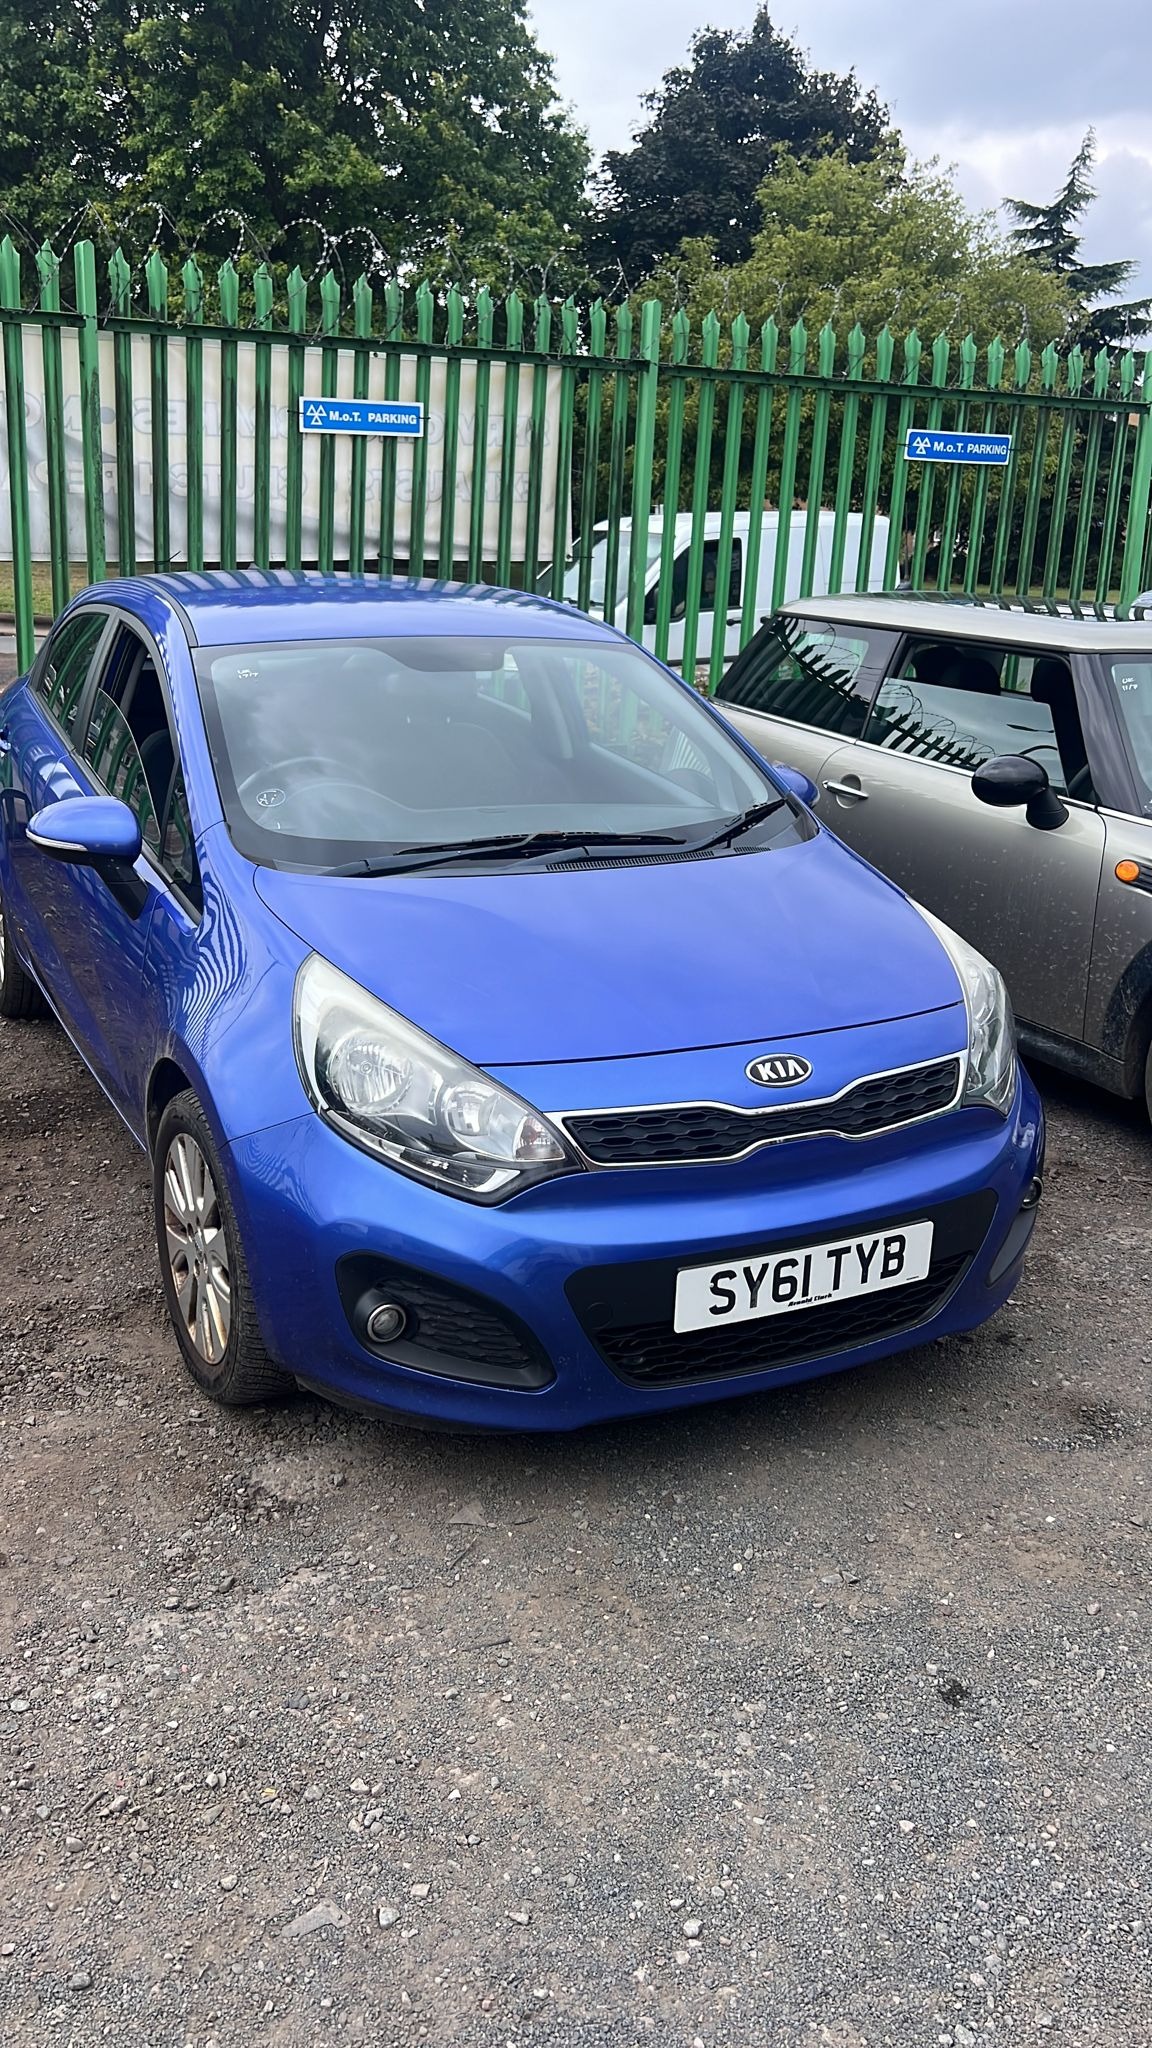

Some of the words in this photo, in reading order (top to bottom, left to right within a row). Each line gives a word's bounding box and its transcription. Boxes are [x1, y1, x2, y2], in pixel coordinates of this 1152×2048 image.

[328, 410, 362, 423] M.o.T.
[367, 412, 417, 425] PARKING
[933, 441, 964, 453] M.o.T.
[967, 443, 1007, 455] PARKING
[756, 1059, 804, 1081] KIA
[709, 1254, 812, 1316] SY61
[827, 1234, 906, 1291] TYB
[788, 1297, 813, 1307] Arnold
[814, 1293, 832, 1302] Clark
